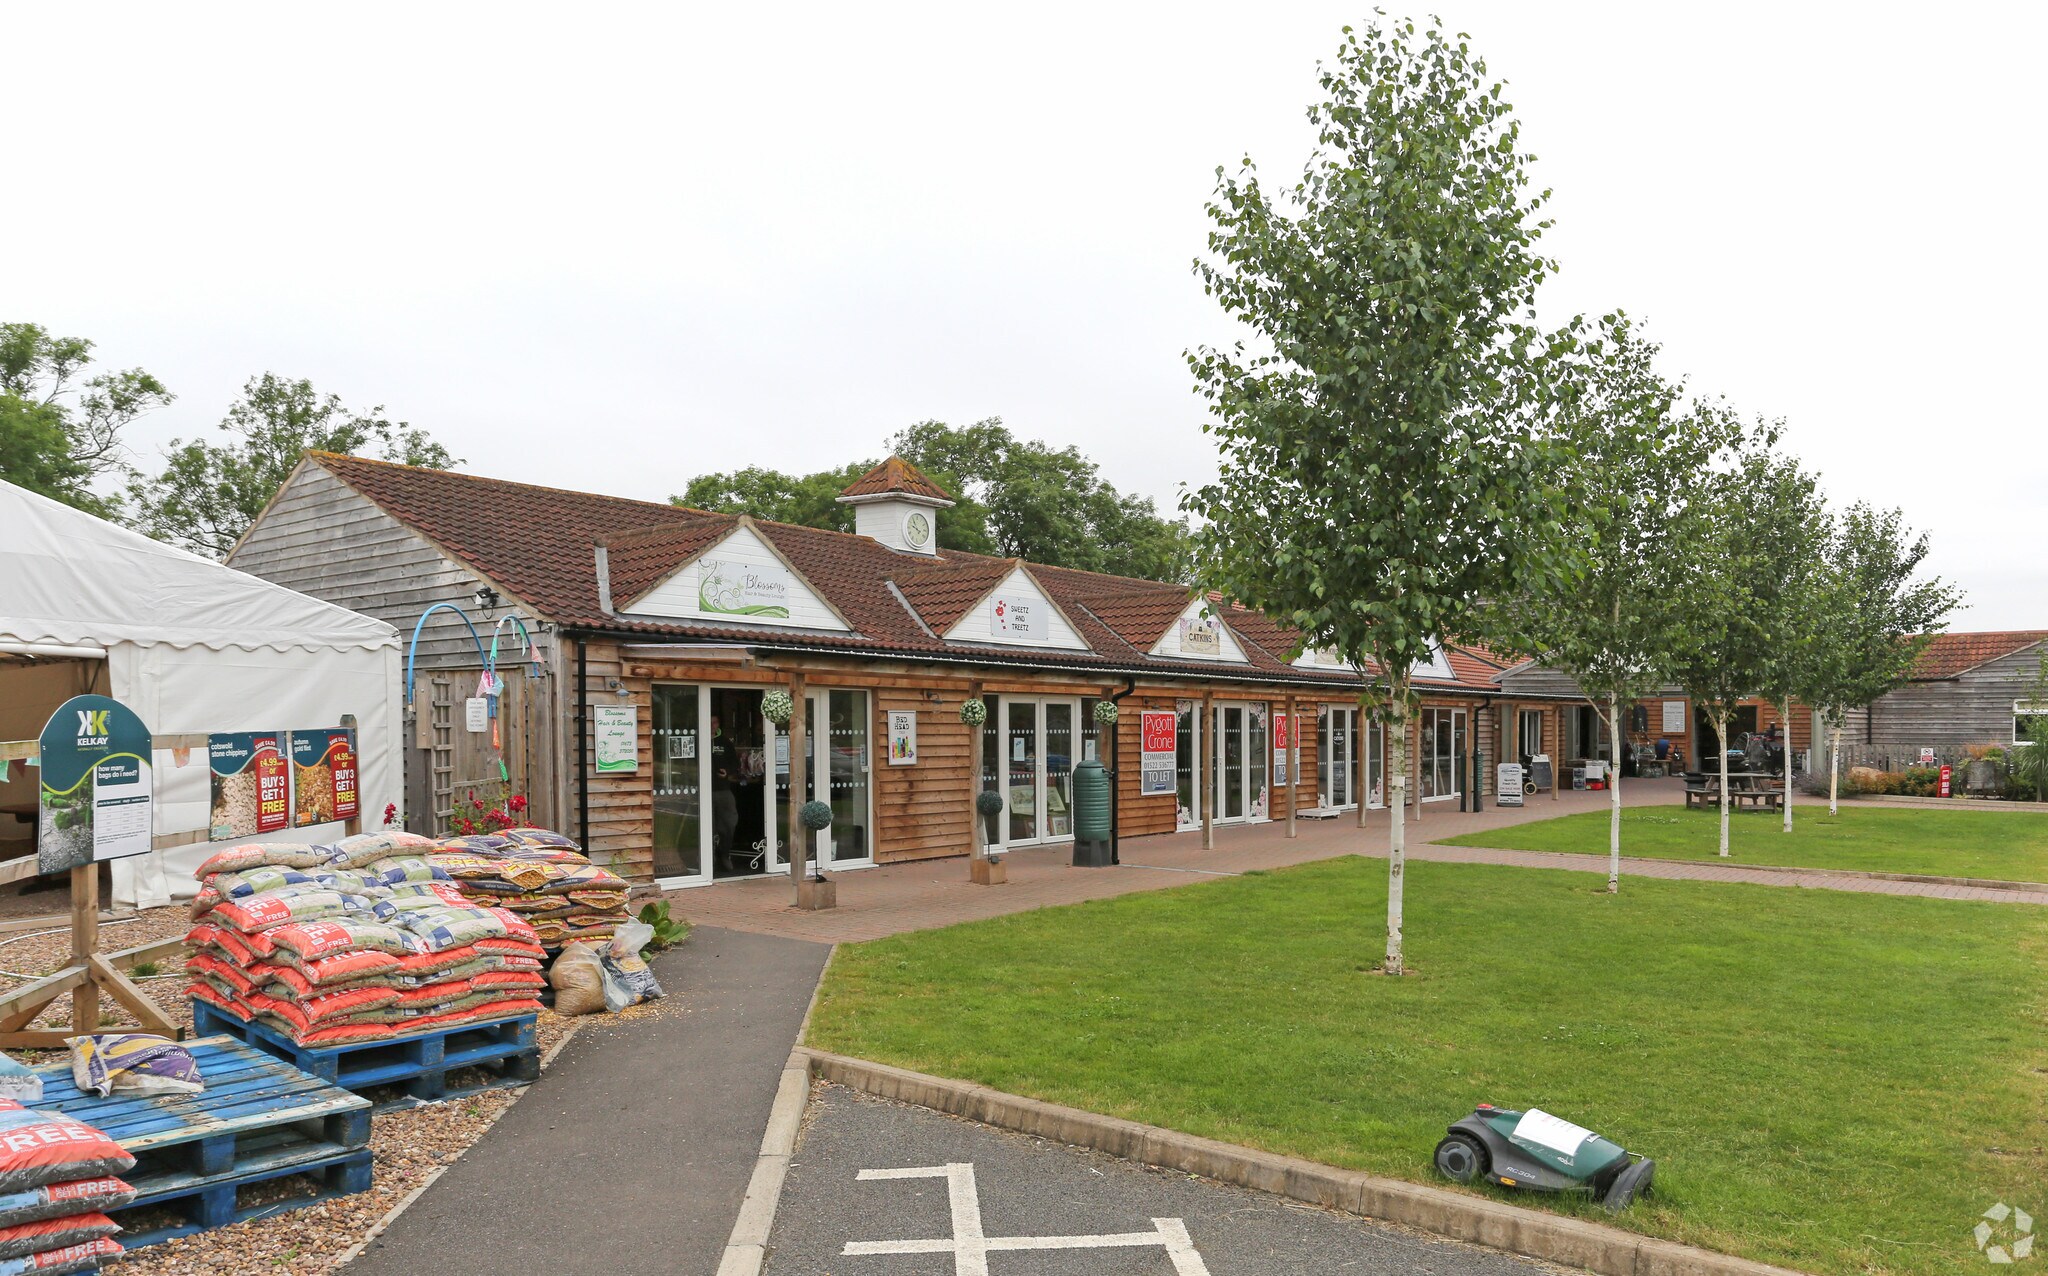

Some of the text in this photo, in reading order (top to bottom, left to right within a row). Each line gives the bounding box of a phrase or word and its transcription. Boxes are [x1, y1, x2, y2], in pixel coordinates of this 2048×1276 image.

[742, 574, 785, 593] Blossoms
[1011, 605, 1029, 614] SWEETZ
[1012, 623, 1029, 631] TREETZ
[1189, 633, 1212, 643] CATKINS
[1145, 715, 1173, 734] Pygott
[77, 737, 108, 746] KELKAY
[211, 742, 233, 750] cotswold
[255, 741, 264, 750] SAVE
[1148, 734, 1173, 749] Crone
[211, 749, 248, 758] stone chippings
[260, 758, 277, 768] £4.99
[111, 765, 125, 773] many
[335, 770, 354, 780] BUY 3
[1148, 771, 1171, 782] TO LET
[261, 776, 285, 788] BUY 3
[336, 781, 349, 791] GET
[261, 789, 278, 800] GET
[336, 791, 355, 803] FREE
[262, 800, 285, 814] FREE
[266, 911, 289, 921] FREE
[327, 938, 349, 949] FREE
[1506, 1167, 1536, 1180] RC304
[76, 1180, 118, 1195] FREE
[64, 1240, 105, 1259] FREE
